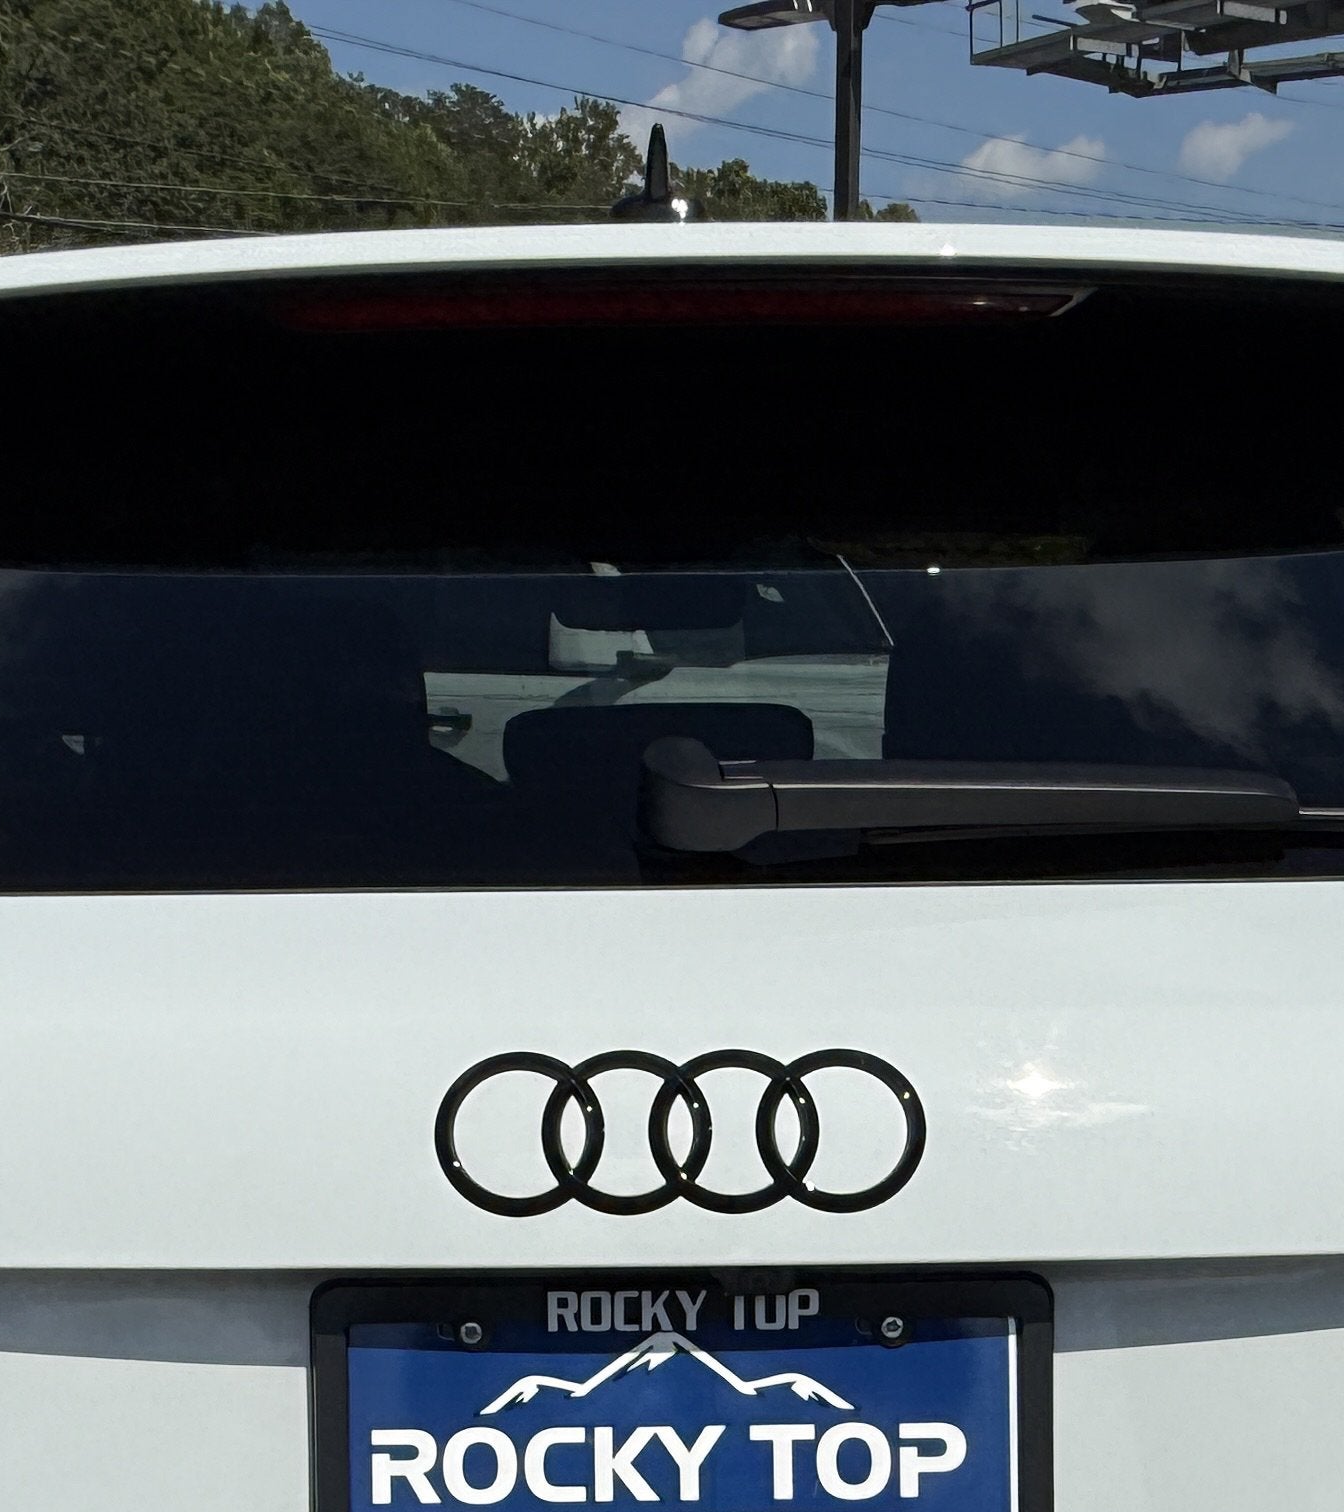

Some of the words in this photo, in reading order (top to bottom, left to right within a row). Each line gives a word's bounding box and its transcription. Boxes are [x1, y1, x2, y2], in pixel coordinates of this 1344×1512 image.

[547, 1289, 707, 1333] ROCKY
[732, 1287, 820, 1332] TOP
[369, 1424, 727, 1506] ROCKY
[749, 1420, 968, 1501] TOP
